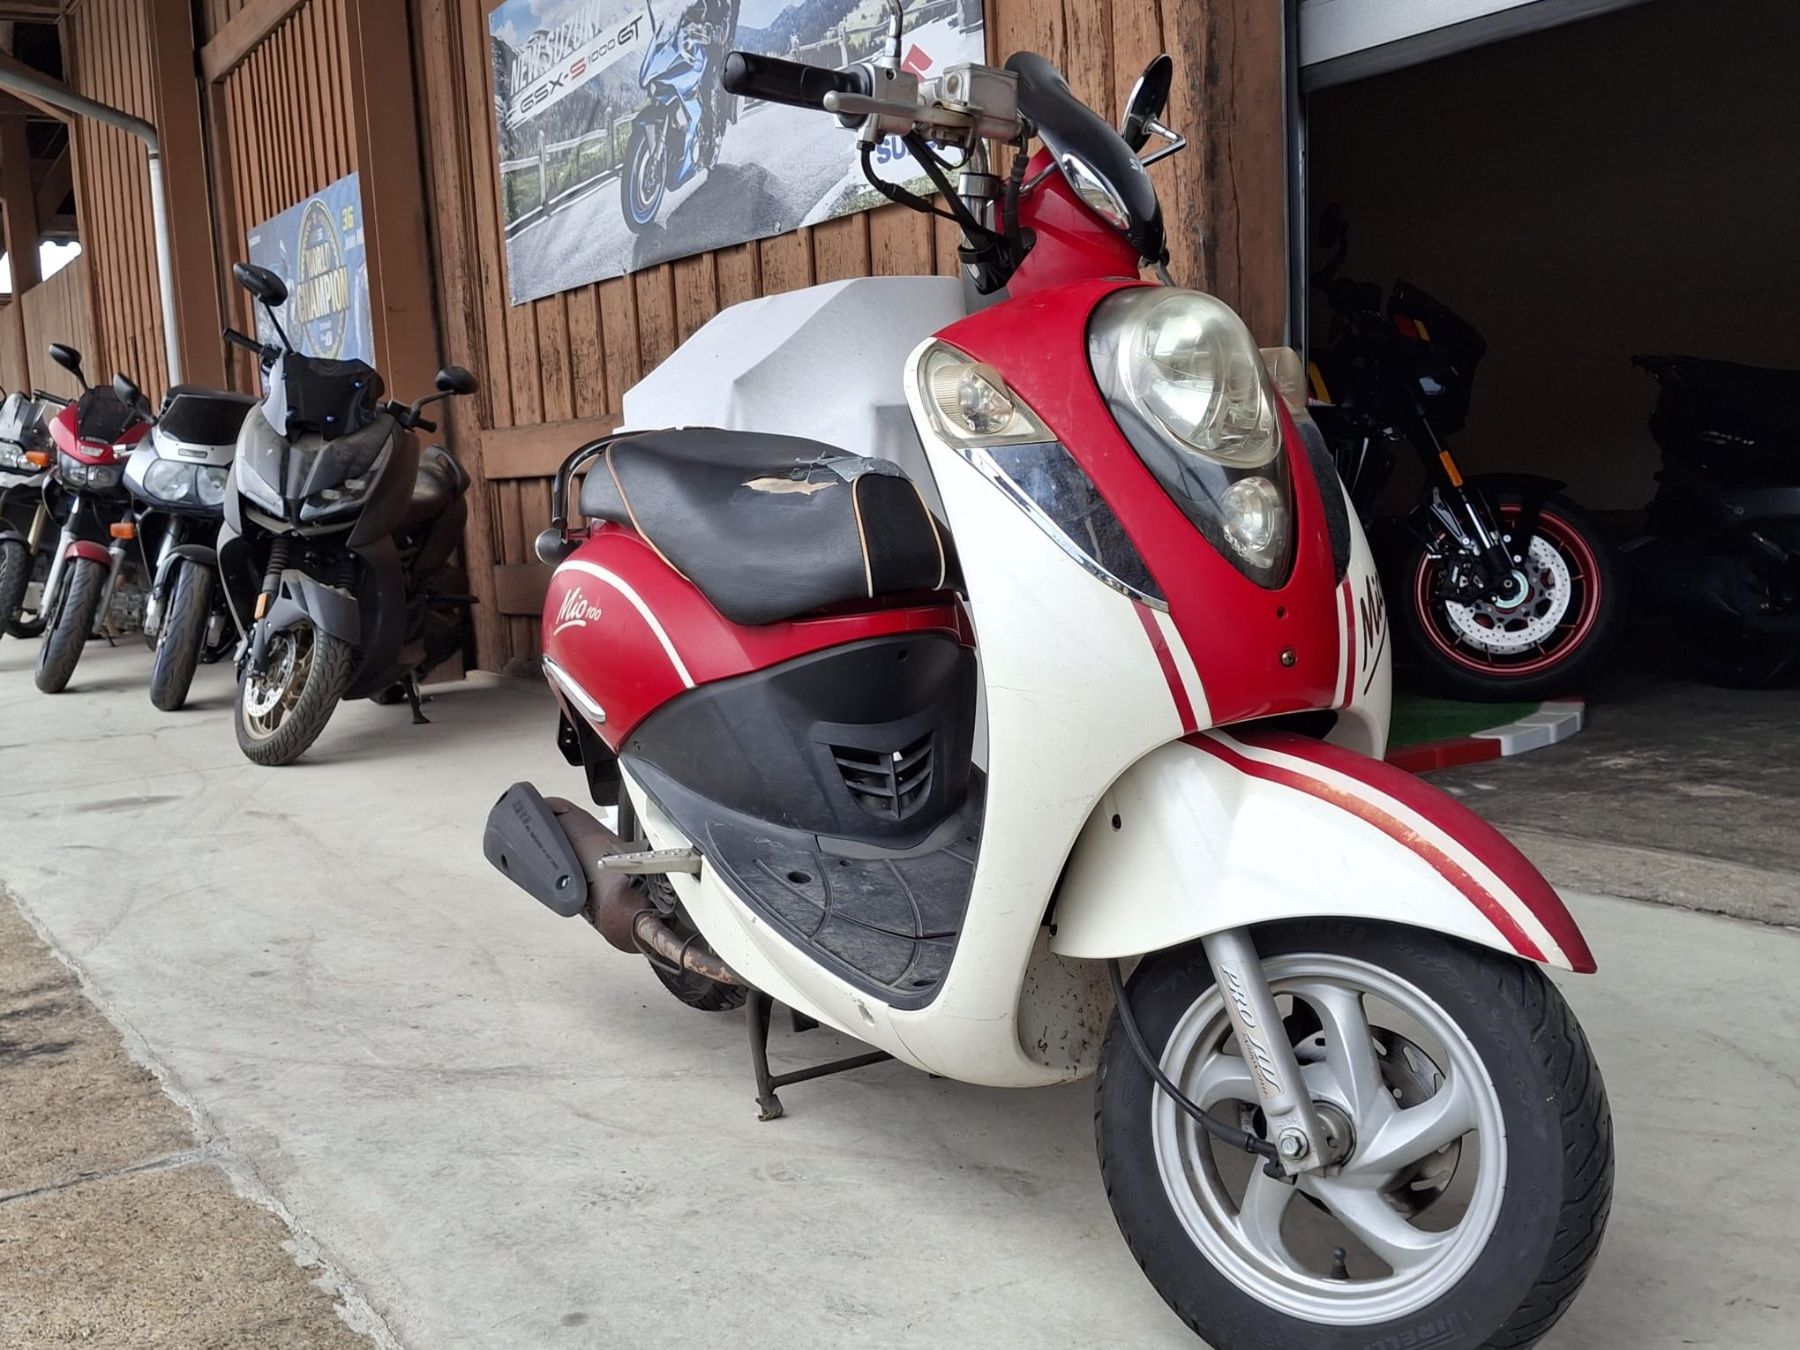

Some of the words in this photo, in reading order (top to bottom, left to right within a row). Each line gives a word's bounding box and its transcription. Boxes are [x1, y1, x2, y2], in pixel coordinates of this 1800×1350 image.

[511, 38, 541, 97] NEW
[342, 205, 354, 231] 36
[305, 242, 331, 279] WORLD
[297, 267, 347, 321] CHAMPION
[556, 587, 588, 624] Mio
[586, 606, 602, 621] 100
